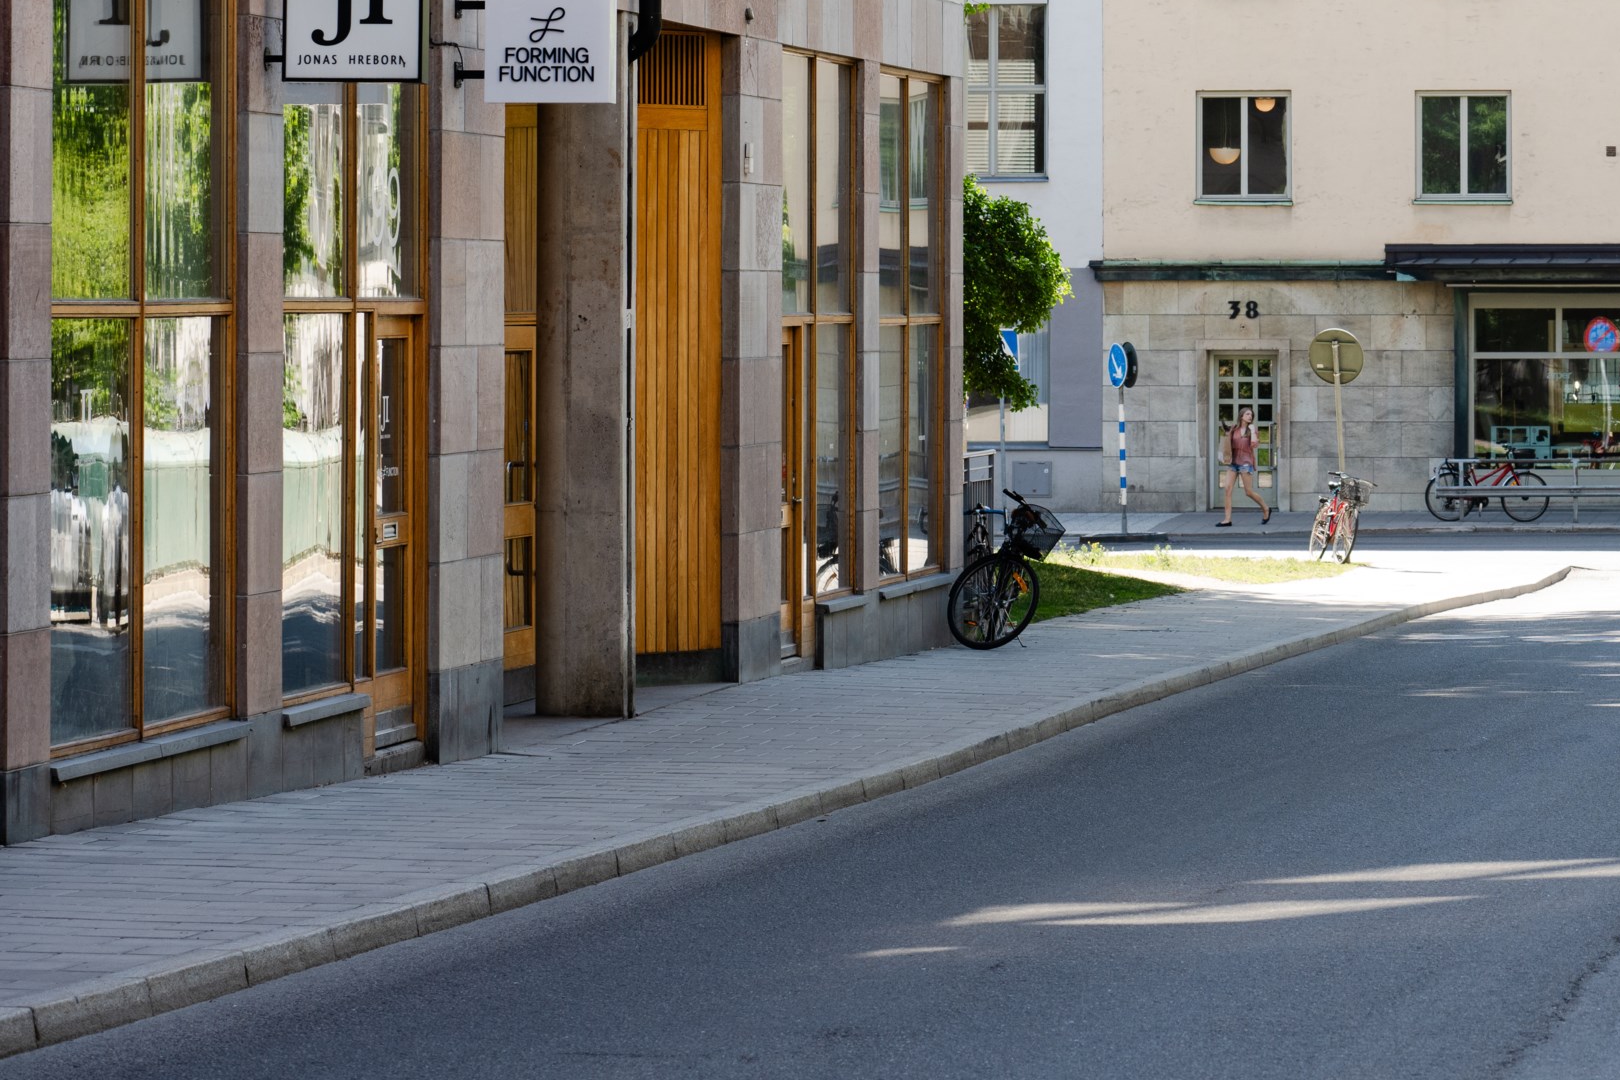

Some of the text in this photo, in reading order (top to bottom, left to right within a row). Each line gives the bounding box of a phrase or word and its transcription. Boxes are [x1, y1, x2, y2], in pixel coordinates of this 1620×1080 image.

[297, 54, 338, 66] JONAS
[504, 46, 590, 64] FORMING
[498, 65, 595, 82] FUNCTION
[1227, 300, 1260, 320] 38
